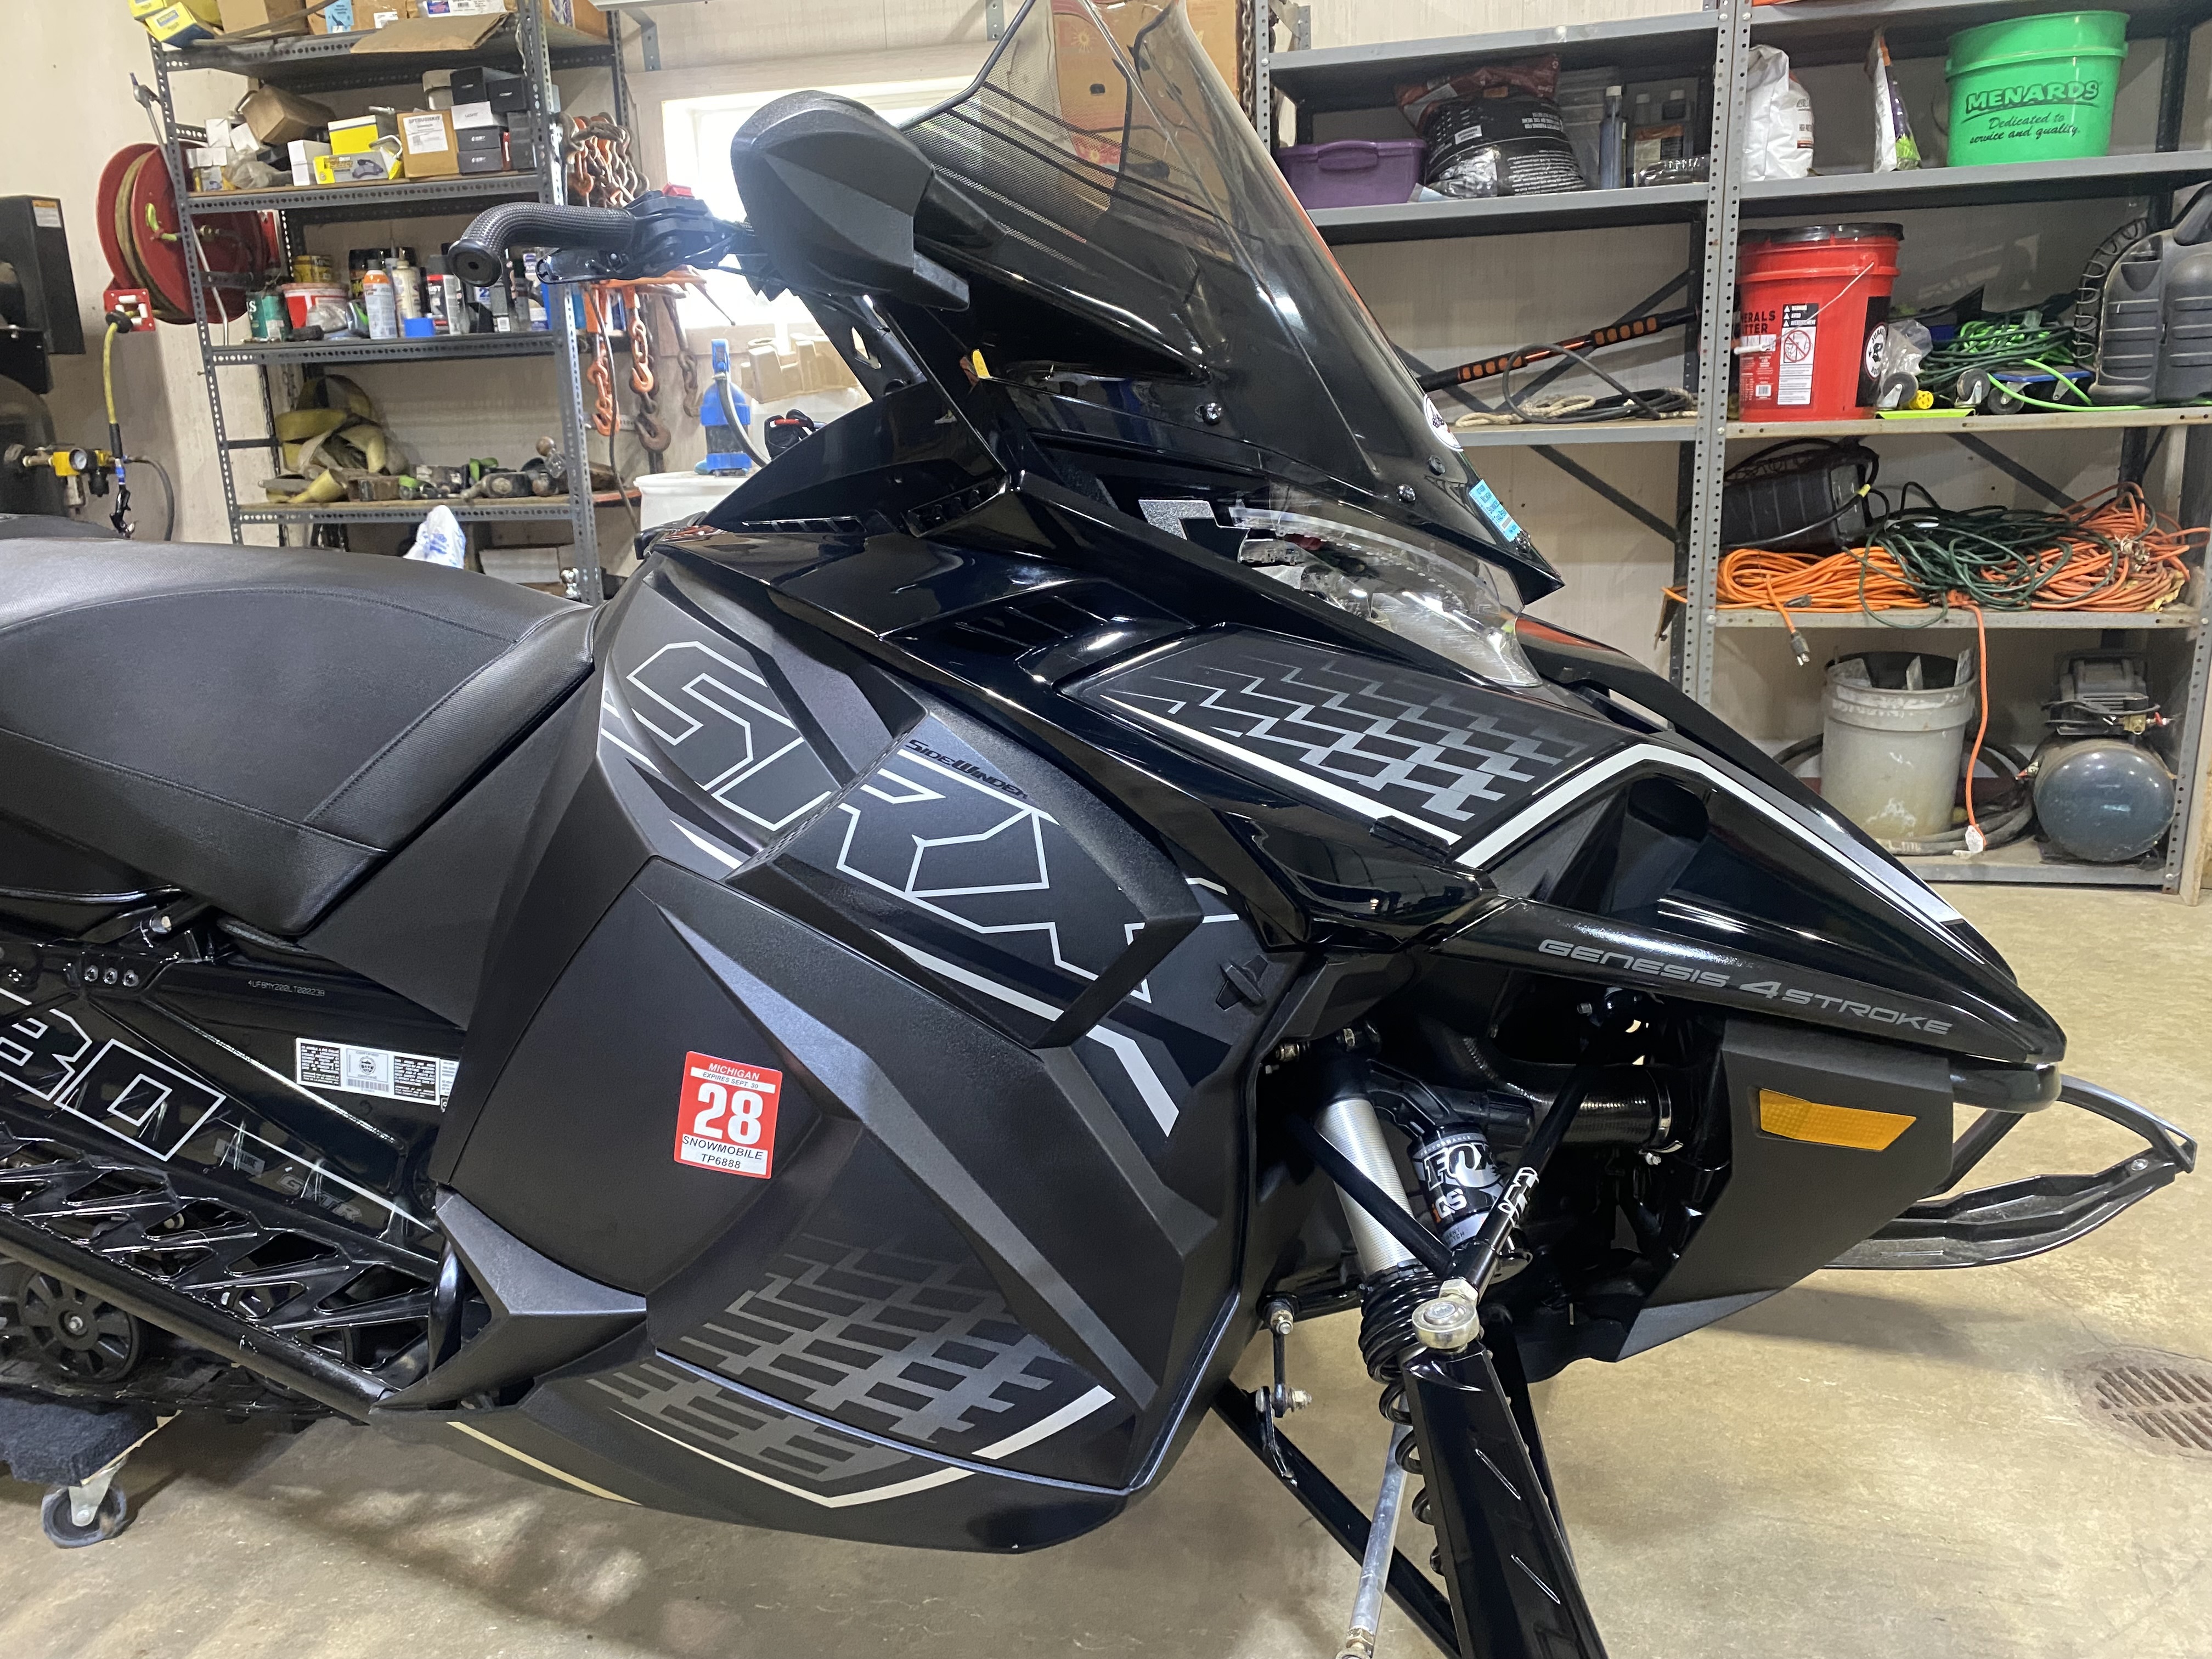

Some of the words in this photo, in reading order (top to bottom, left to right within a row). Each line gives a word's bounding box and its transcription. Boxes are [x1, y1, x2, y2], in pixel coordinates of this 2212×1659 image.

[1966, 80, 2099, 114] MENARDS
[1989, 112, 2052, 130] Dedicated
[2054, 113, 2065, 122] to
[1970, 131, 2005, 144] service
[2008, 127, 2032, 138] and
[1538, 938, 1730, 988] GENESIS
[703, 1071, 730, 1084] EXPIRES
[731, 1078, 749, 1087] SEPT.
[708, 1063, 760, 1081] MICHIGAN
[693, 1082, 764, 1145] 28
[682, 1136, 764, 1160] SNOWMOBILE
[701, 1153, 741, 1169] TP6888
[276, 1173, 363, 1223] GYTR
